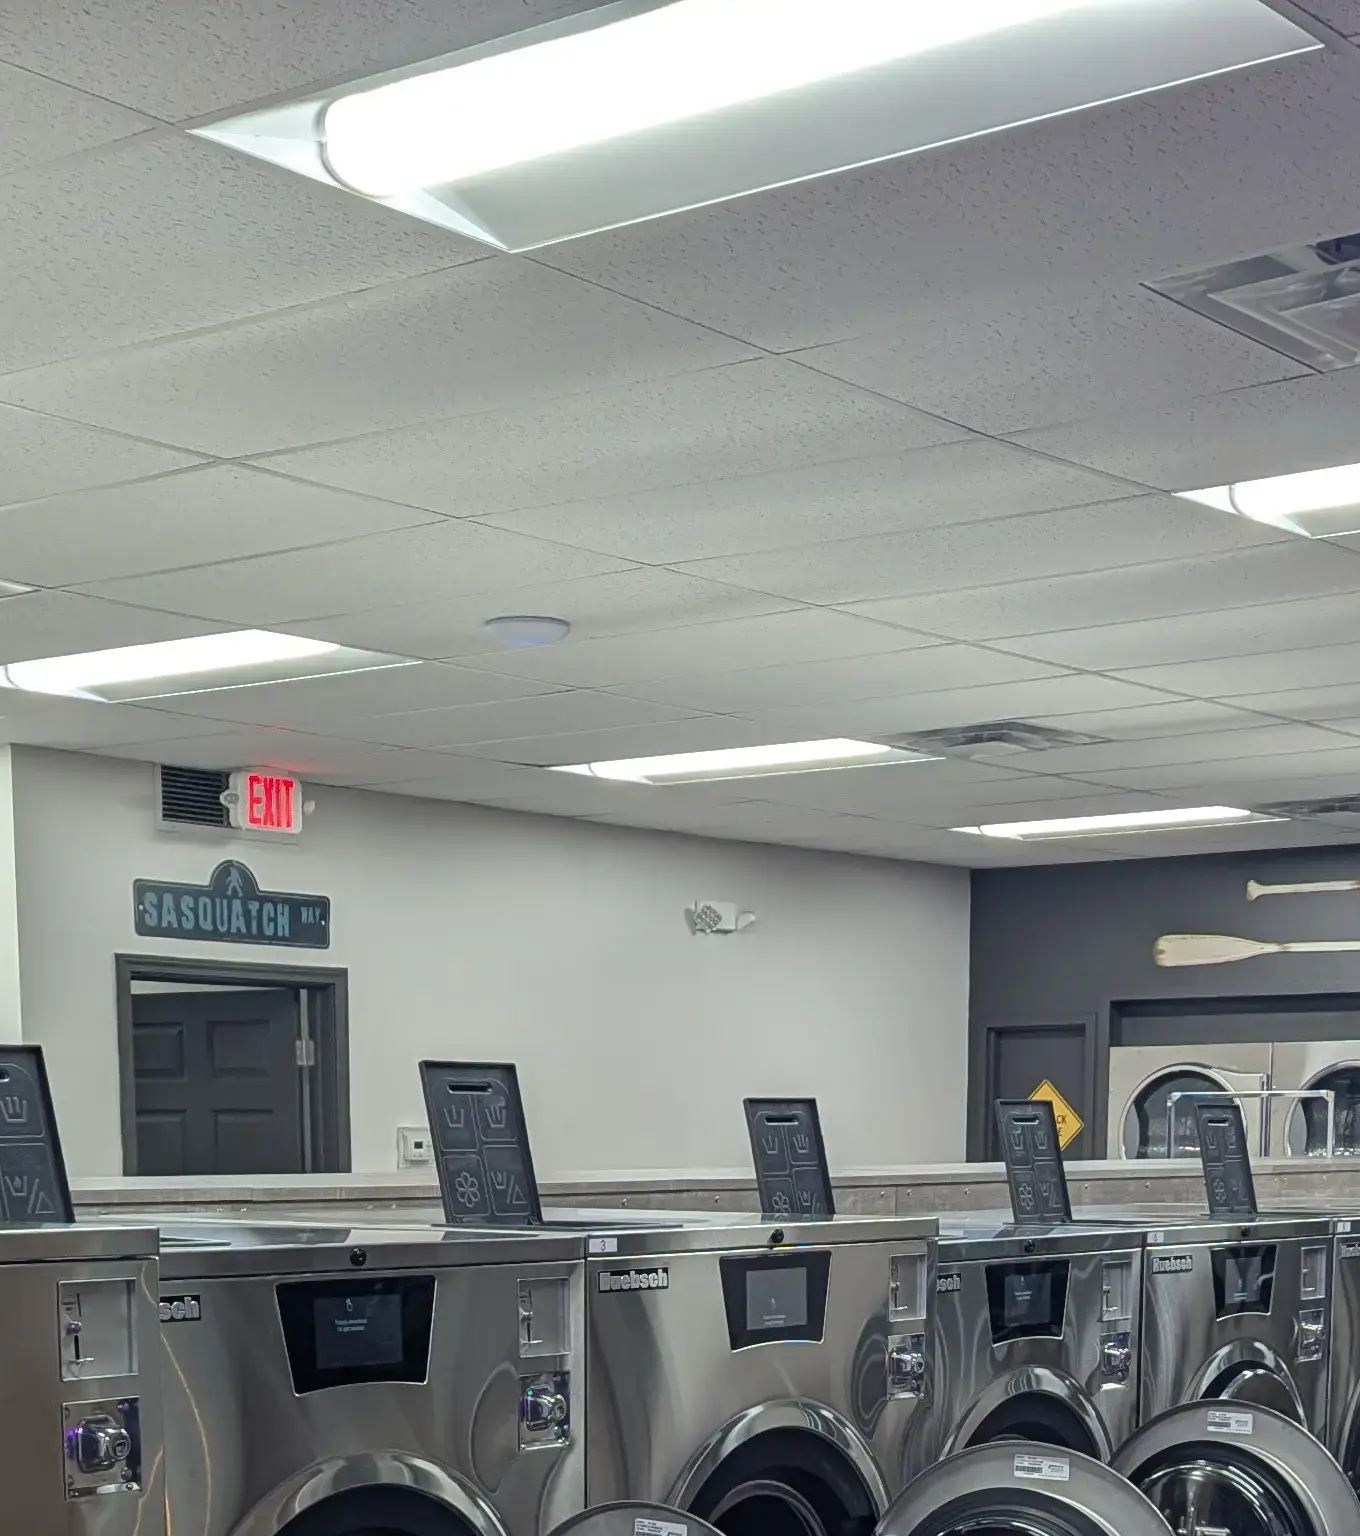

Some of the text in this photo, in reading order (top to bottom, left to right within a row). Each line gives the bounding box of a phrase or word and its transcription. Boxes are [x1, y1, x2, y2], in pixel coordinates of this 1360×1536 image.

[248, 775, 294, 828] EXIT
[143, 892, 321, 938] SASQUATCH WAY
[600, 1239, 607, 1251] 3
[1152, 1255, 1192, 1273] Huebsch
[599, 1268, 669, 1291] Huebsch
